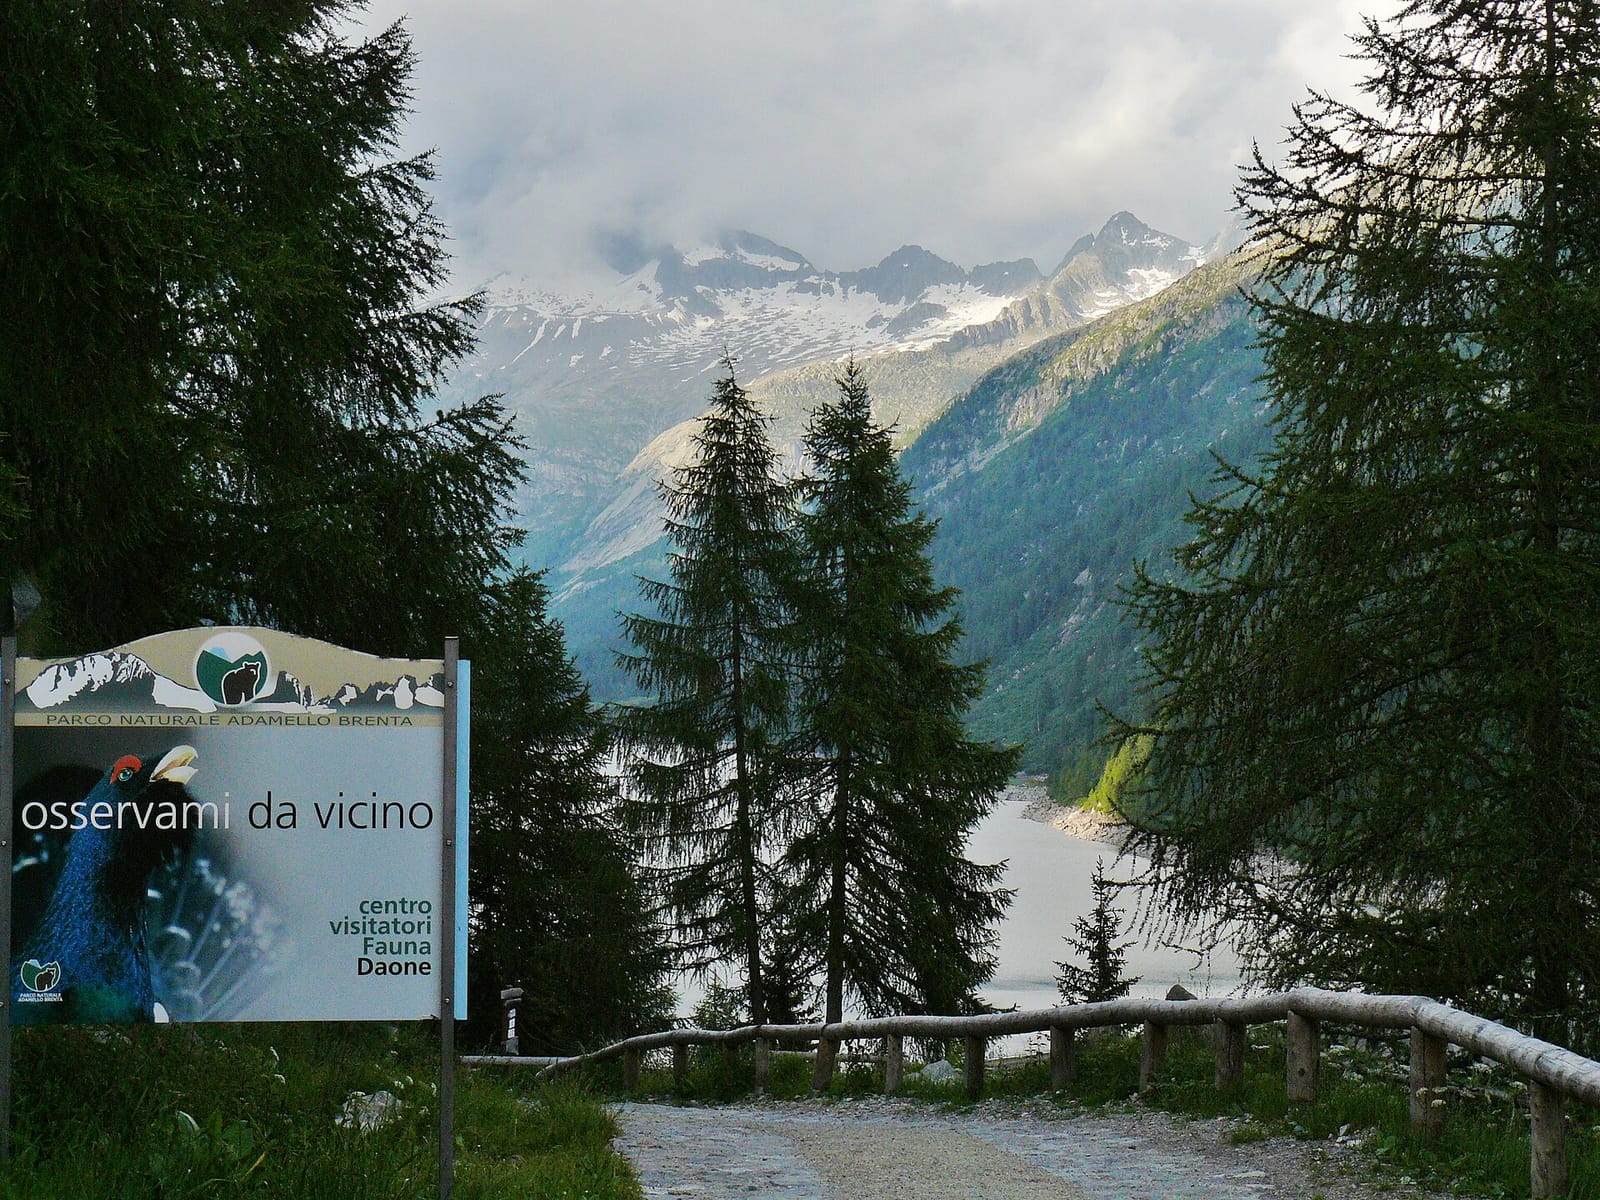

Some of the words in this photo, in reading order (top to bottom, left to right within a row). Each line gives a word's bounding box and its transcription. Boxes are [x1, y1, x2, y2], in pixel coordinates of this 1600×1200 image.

[46, 714, 112, 726] PARCO
[120, 714, 220, 726] NATURALE
[227, 715, 331, 726] ADAMELLO
[338, 715, 413, 726] BRENTA
[21, 791, 230, 830] osservami
[248, 790, 297, 829] da
[313, 791, 434, 829] vicino
[359, 897, 432, 914] centro
[329, 916, 431, 935] visitatori
[363, 937, 431, 955] Fauna
[357, 957, 432, 976] Daone
